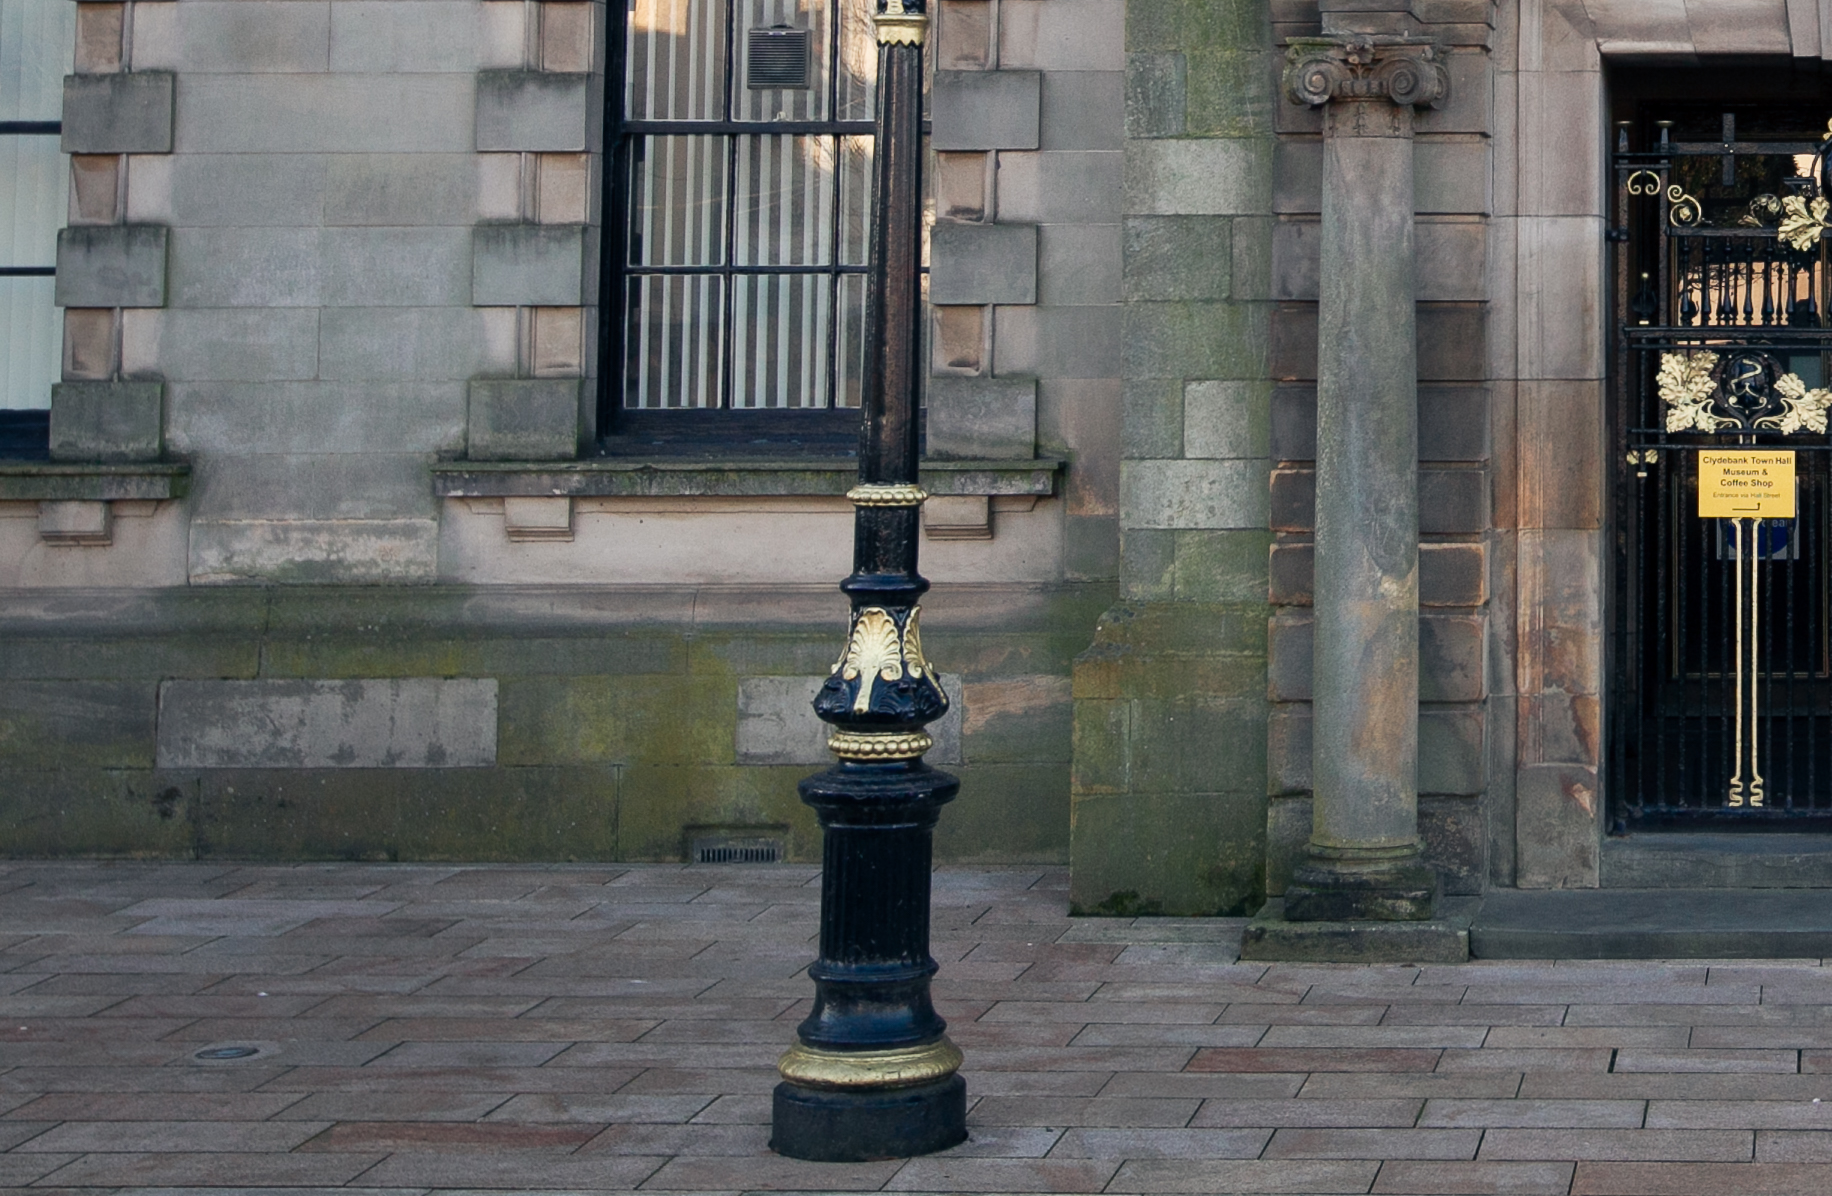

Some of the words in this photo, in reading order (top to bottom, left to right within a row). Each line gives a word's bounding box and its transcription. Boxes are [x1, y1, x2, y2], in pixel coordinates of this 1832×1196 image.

[1703, 456, 1748, 465] Clydebank
[1751, 456, 1774, 464] Town
[1775, 456, 1792, 464] Hall
[1723, 468, 1759, 476] Museum
[1762, 468, 1768, 476] &
[1720, 479, 1748, 487] Coffee
[1750, 479, 1774, 488] Shop
